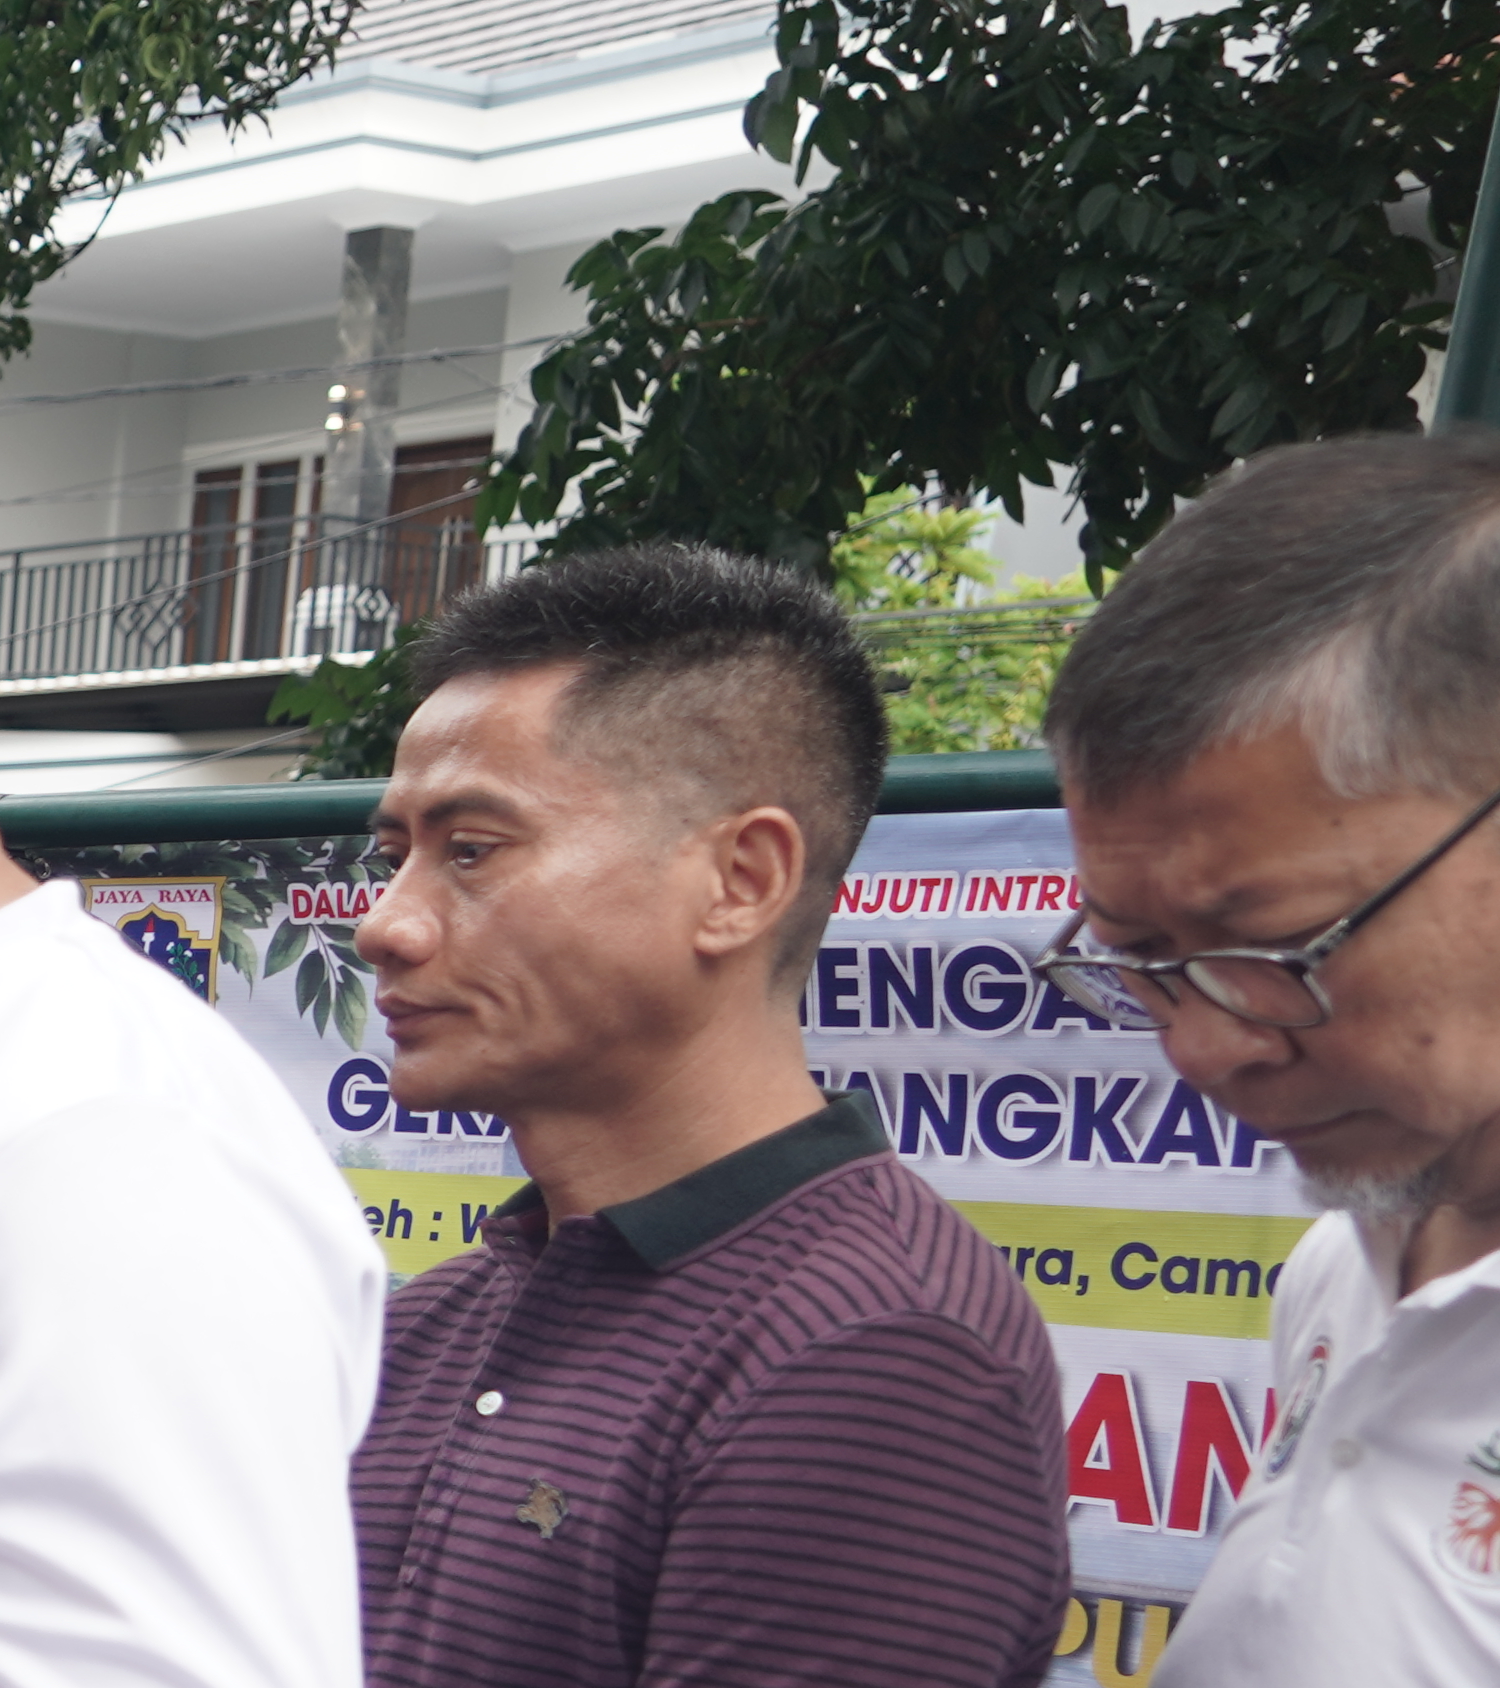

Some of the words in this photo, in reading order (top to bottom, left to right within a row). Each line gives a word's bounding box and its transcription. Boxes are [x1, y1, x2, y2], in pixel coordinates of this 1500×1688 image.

[93, 889, 143, 905] JAYA
[158, 888, 213, 903] RAYA
[292, 886, 386, 919] DALA
